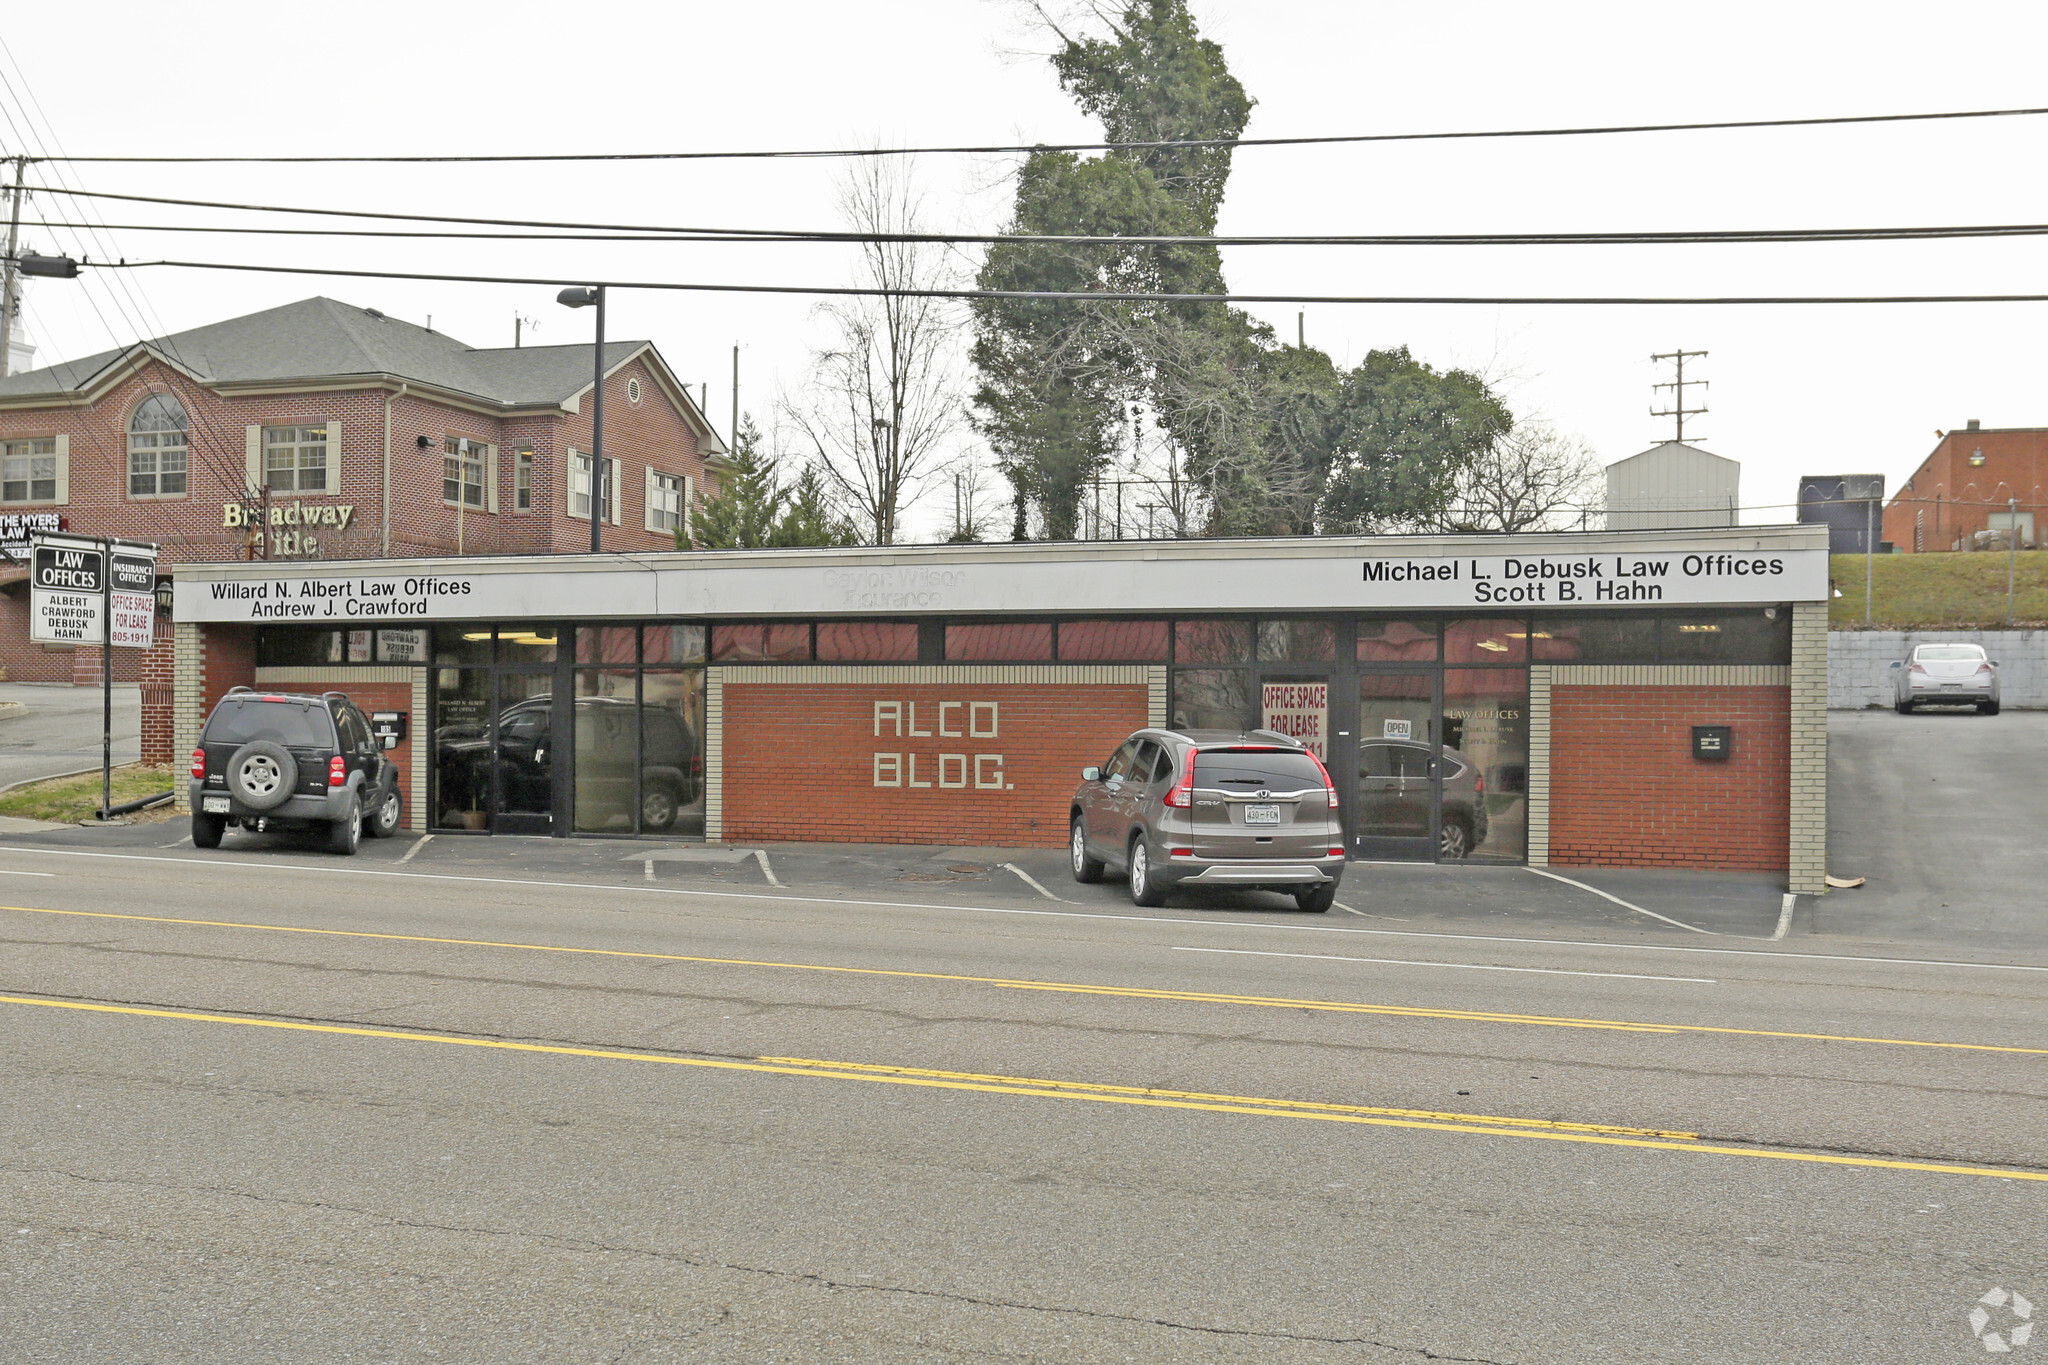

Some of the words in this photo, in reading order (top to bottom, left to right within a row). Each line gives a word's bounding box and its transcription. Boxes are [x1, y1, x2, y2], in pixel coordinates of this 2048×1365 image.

[0, 514, 19, 527] THE
[22, 514, 60, 527] MYERS
[223, 501, 353, 530] Bradway
[0, 527, 26, 539] LAW
[55, 551, 85, 569] LAW
[1362, 560, 1459, 582] Michael
[1471, 560, 1492, 580] L.
[1504, 558, 1603, 580] Debusk
[1616, 557, 1670, 578] Law
[1682, 554, 1784, 577] Offices
[113, 563, 153, 575] INSURANCE
[42, 568, 96, 588] OFFICES
[119, 573, 147, 584] OFFICES
[211, 582, 267, 600] Willard
[275, 582, 292, 598] N.
[300, 581, 352, 598] Albert
[360, 579, 396, 597] Law
[404, 578, 471, 596] Offices
[1474, 581, 1546, 603] Scott
[1558, 581, 1584, 601] B.
[1596, 580, 1663, 601] Hahn
[50, 596, 88, 607] ALBERT
[112, 595, 133, 611] OFFICE
[134, 598, 153, 612] SPACE
[251, 601, 315, 617] Andrew
[324, 601, 338, 616] J.
[346, 598, 427, 616] Crawford
[41, 607, 96, 619] CRAWFORD
[115, 613, 128, 628] FOR
[129, 614, 147, 629] LEASE
[48, 618, 89, 629] DEBUSK
[54, 629, 83, 639] HAHN
[112, 631, 149, 643] 805-1911
[1264, 686, 1295, 709] OFFICE
[1297, 686, 1326, 709] SPACE
[874, 701, 998, 738] ALCO
[1450, 710, 1473, 719] LAW
[1474, 710, 1519, 719] OFFICES
[1271, 715, 1288, 735] FOR
[1290, 715, 1319, 737] LEASE
[1387, 722, 1409, 734] OPEN
[873, 752, 1014, 790] BLDG.
